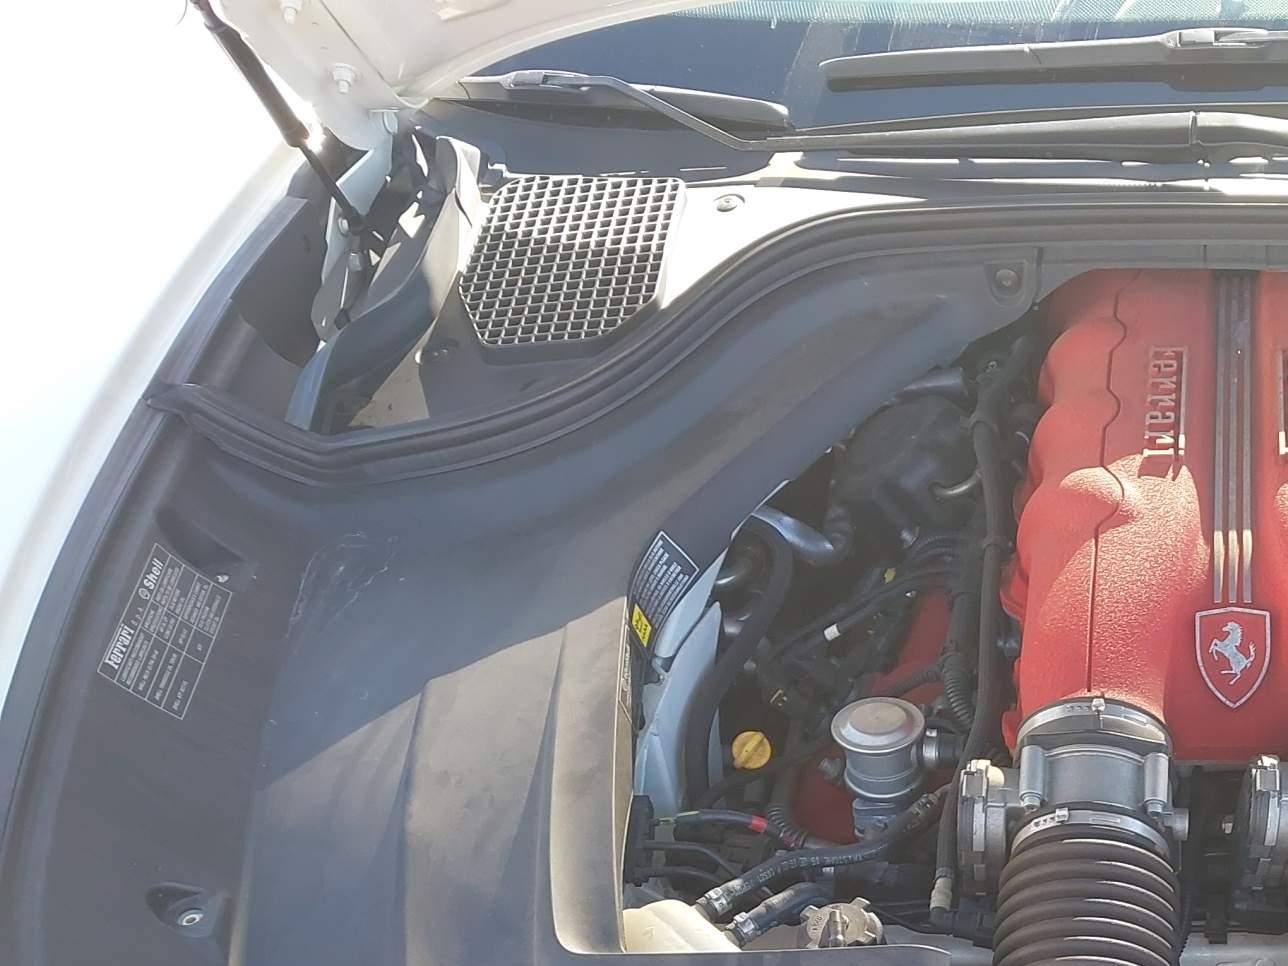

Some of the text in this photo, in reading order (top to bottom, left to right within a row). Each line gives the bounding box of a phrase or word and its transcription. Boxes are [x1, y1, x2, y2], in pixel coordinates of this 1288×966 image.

[1143, 346, 1186, 456] Ferrari
[143, 558, 163, 590] Shell
[105, 624, 135, 669] Ferrari
